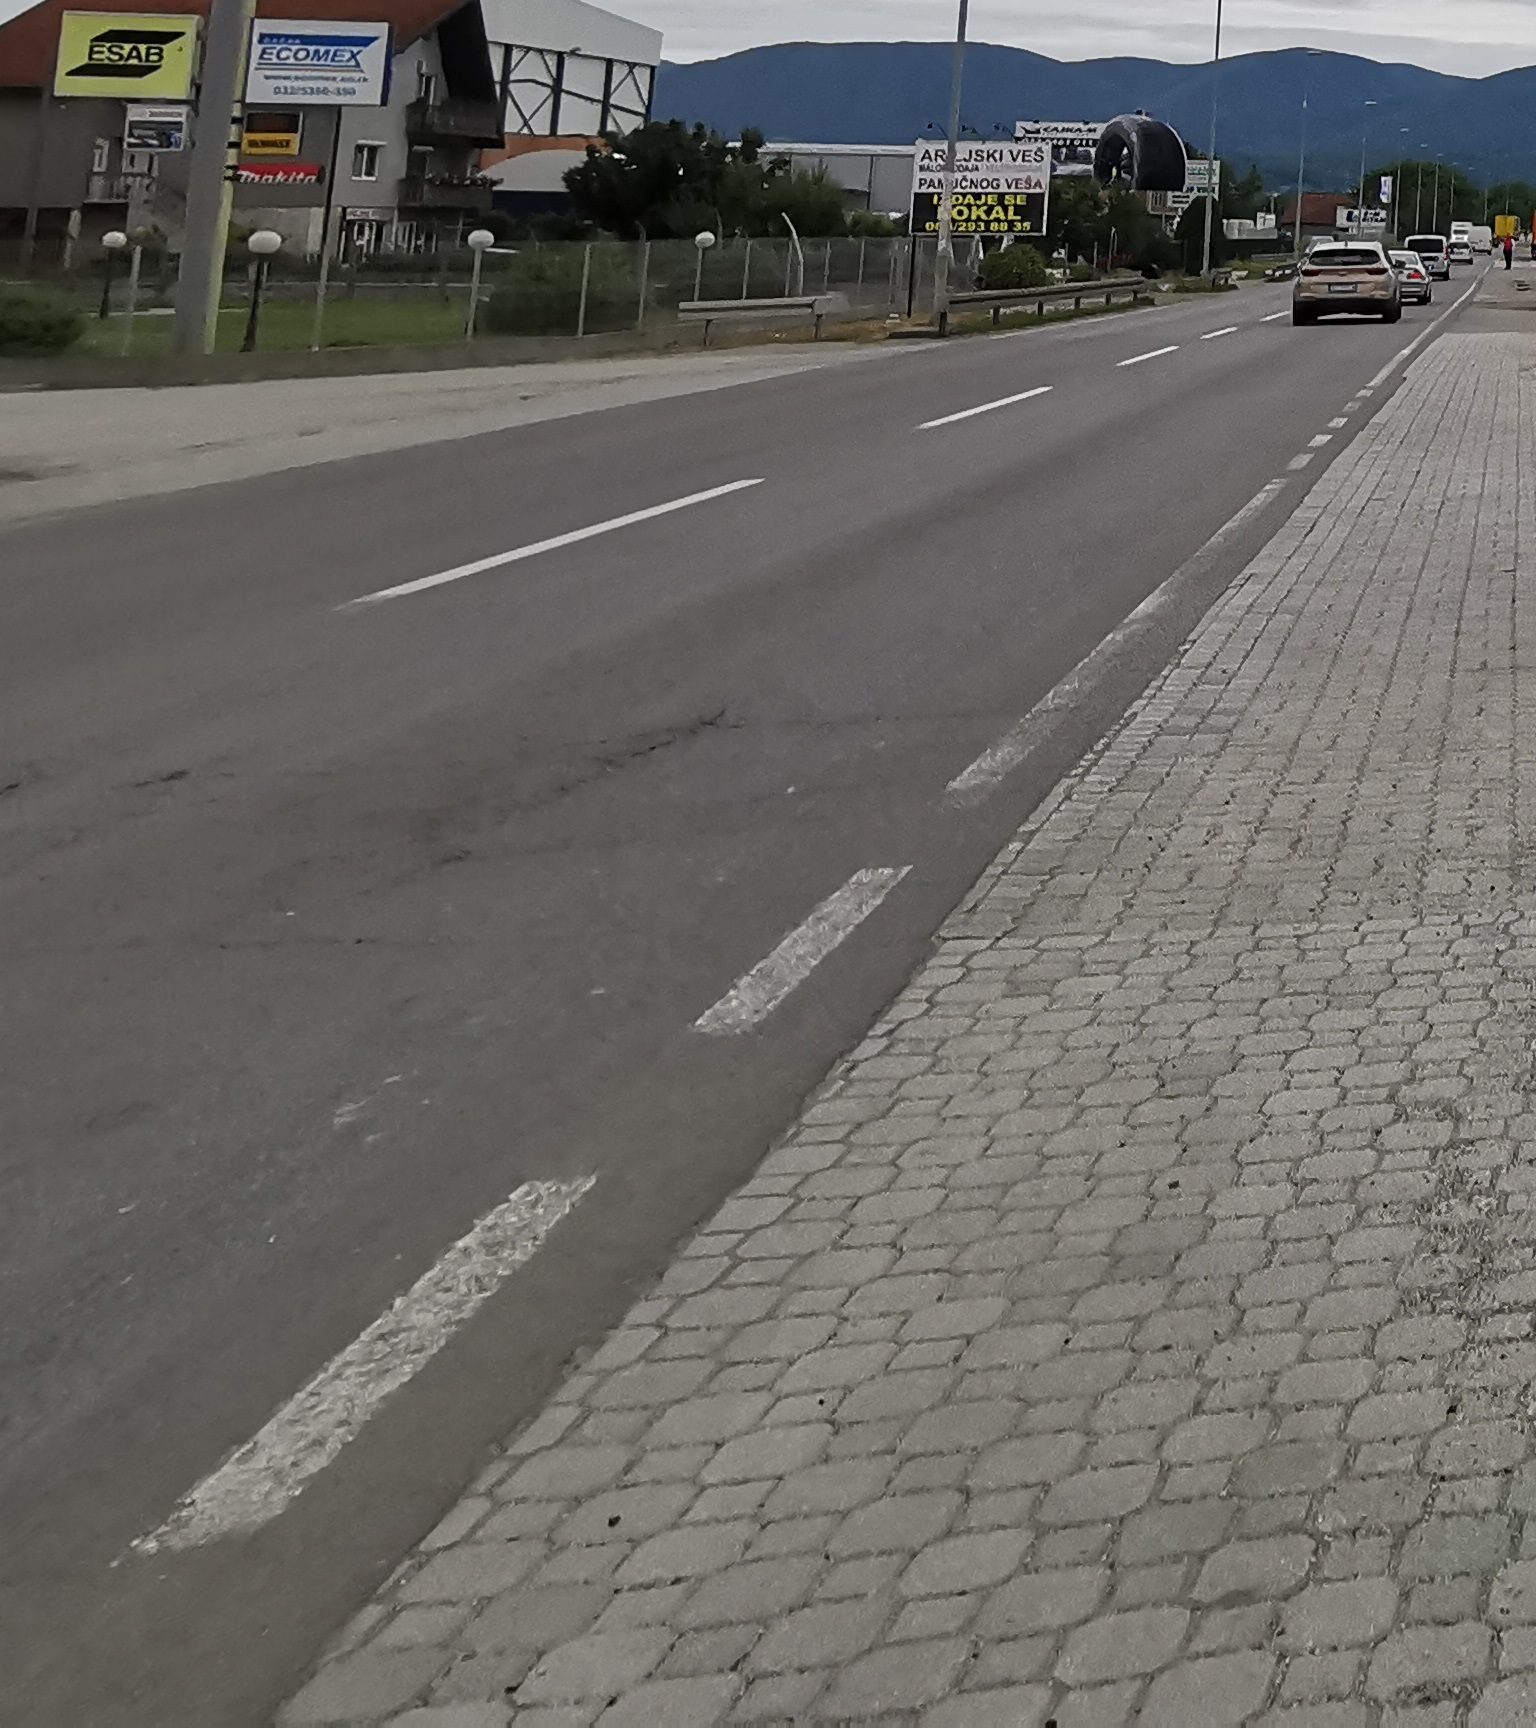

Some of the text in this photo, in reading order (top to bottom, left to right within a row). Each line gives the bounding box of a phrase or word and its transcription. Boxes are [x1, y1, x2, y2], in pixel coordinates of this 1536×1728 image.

[88, 44, 165, 63] ESAB
[257, 46, 364, 68] ECOMEX
[920, 146, 1045, 163] ARJSKI VEŠ
[1005, 174, 1043, 190] VEŠA
[932, 194, 1028, 206] IDAJE SE
[937, 205, 1022, 221] OKAL
